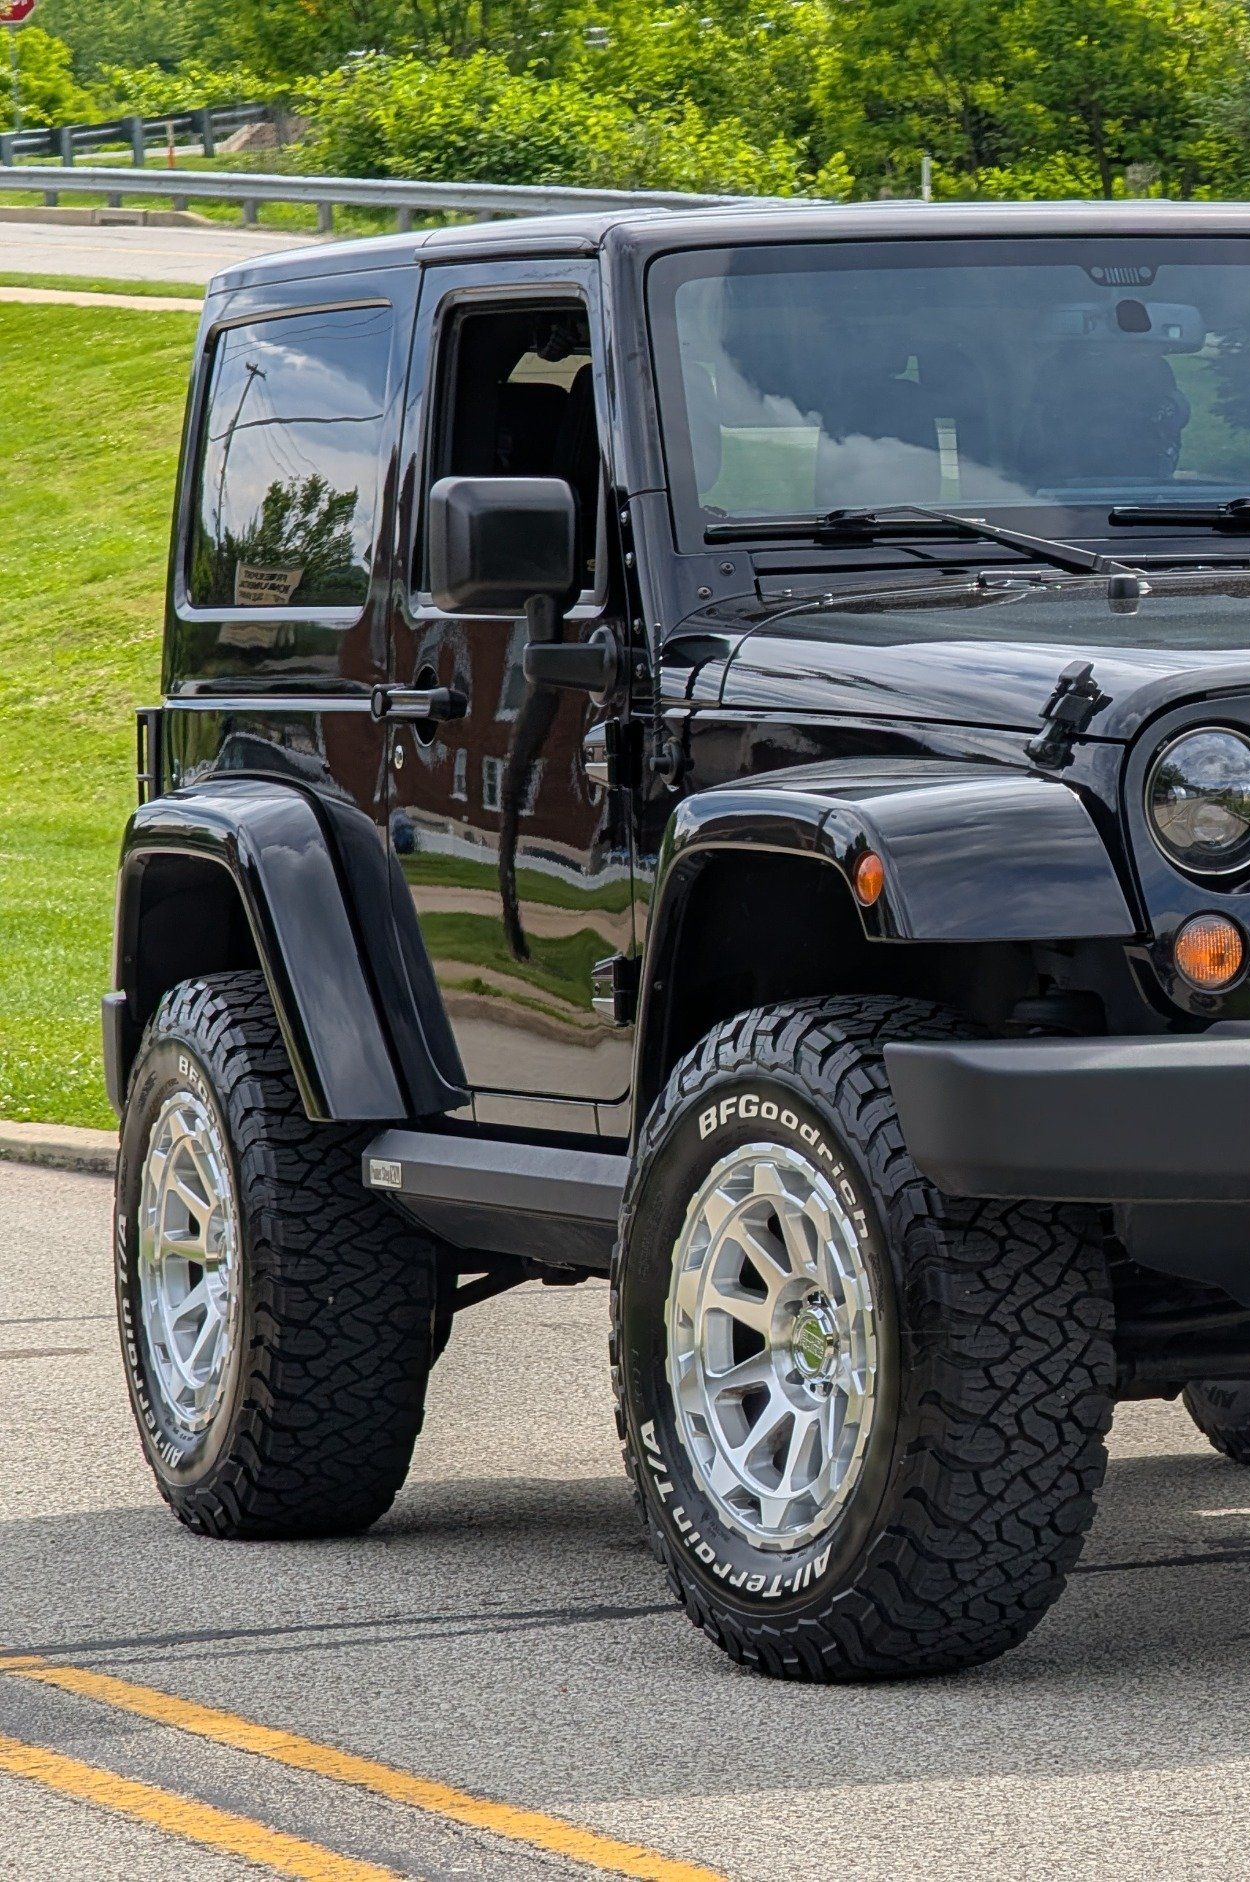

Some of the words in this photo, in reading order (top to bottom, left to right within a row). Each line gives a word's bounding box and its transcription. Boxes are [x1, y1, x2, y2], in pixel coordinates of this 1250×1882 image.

[698, 1093, 869, 1239] BFGoodrich
[122, 1298, 185, 1469] All-Terrain
[639, 1418, 674, 1503] T/A
[672, 1505, 834, 1598] All-Terrain
